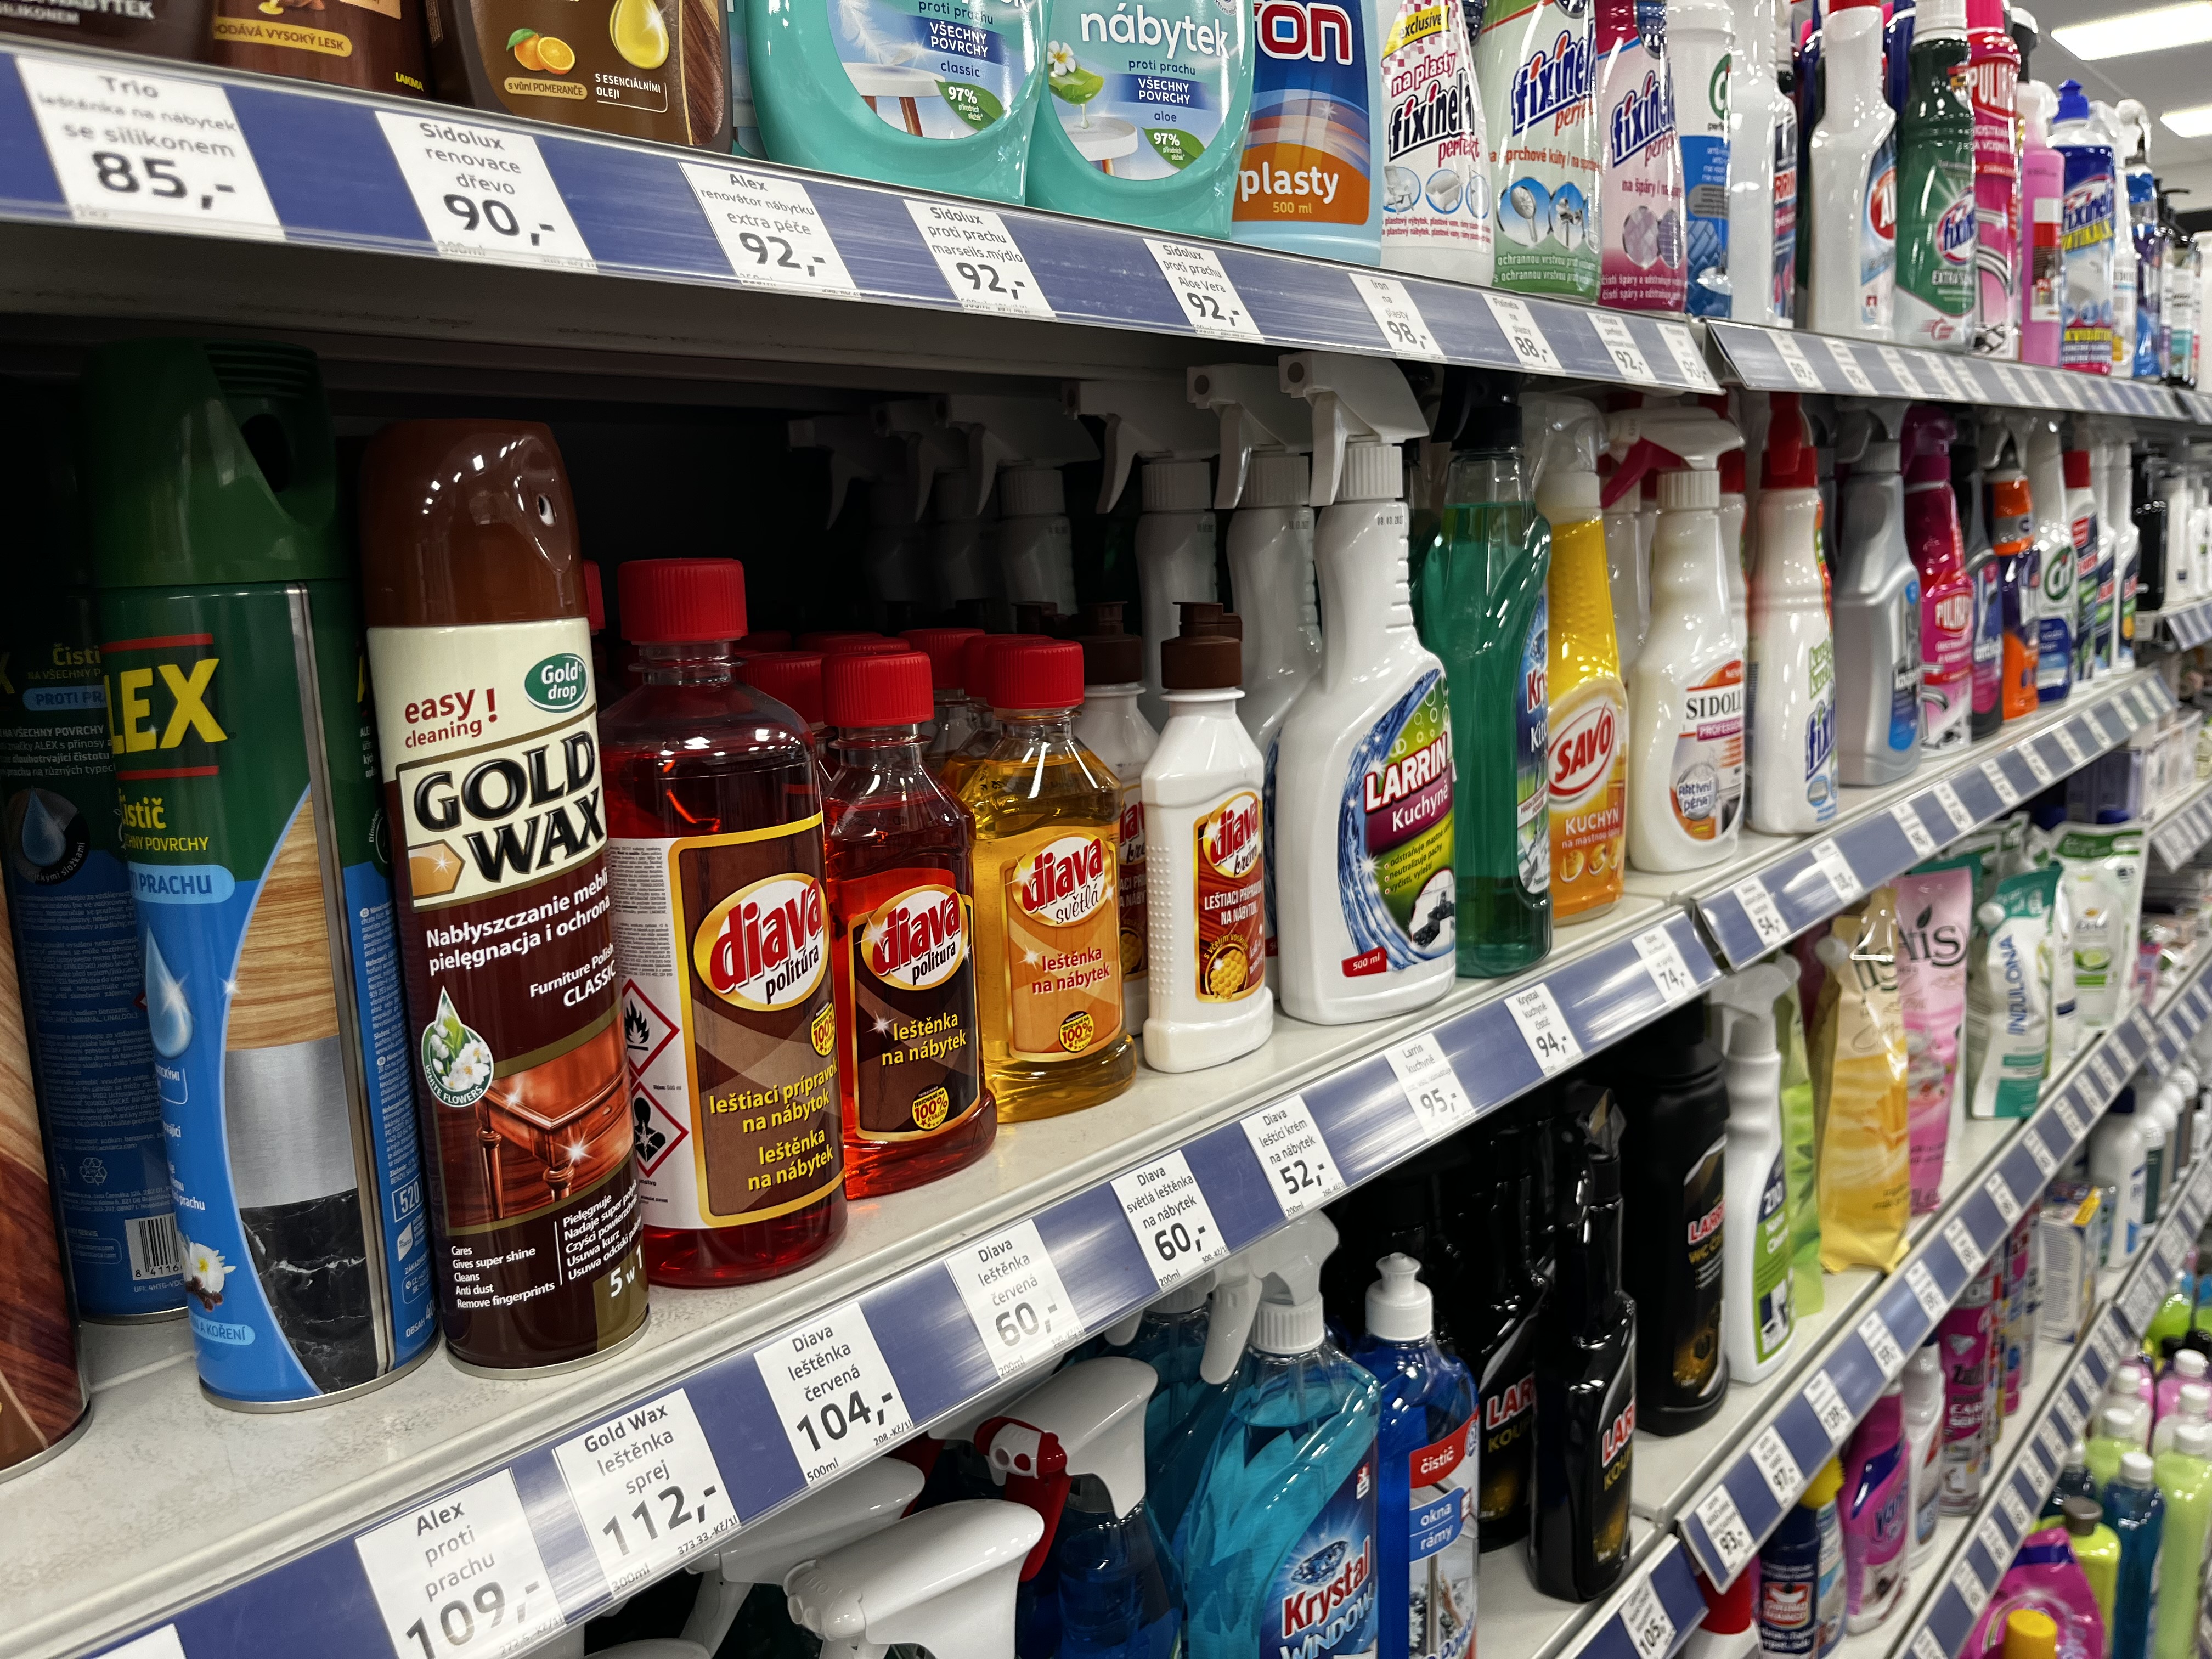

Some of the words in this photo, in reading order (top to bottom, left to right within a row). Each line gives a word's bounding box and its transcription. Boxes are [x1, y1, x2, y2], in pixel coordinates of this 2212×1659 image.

[918, 0, 950, 15] proti
[954, 4, 994, 25] prachu
[266, 26, 315, 45] VYSOKÝ
[318, 34, 344, 51] LESK
[929, 20, 986, 44] VŠECHNY
[1081, 7, 1229, 59] nábytek
[1398, 13, 1442, 41] exclusive
[930, 36, 988, 57] POVRCHY
[940, 60, 980, 78] classic
[1128, 59, 1156, 72] proti
[1160, 62, 1196, 76] prachu
[98, 75, 159, 98] Trio
[395, 72, 424, 92] LAKMA
[514, 80, 532, 92] vůní
[533, 81, 584, 97] POMERANČE
[596, 86, 620, 100] OLEJI
[603, 74, 661, 94] ESENCIÁLNÍMI
[947, 86, 977, 104] 97%
[1138, 76, 1189, 93] VŠECHNY
[1138, 89, 1190, 105] POVRCHY
[161, 109, 237, 132] nábytek
[1154, 110, 1177, 122] aloe
[63, 122, 94, 139] se
[105, 126, 235, 158] silikonem
[419, 121, 505, 151] Sidolux
[1153, 132, 1180, 146] 97%
[425, 146, 521, 174] renovace
[91, 151, 235, 210] 85,-
[456, 172, 516, 195] dřevo
[729, 173, 768, 191] Alex
[1238, 162, 1338, 204] plasty
[699, 187, 763, 208] renovátor
[766, 200, 815, 216] nábytku
[1273, 201, 1295, 213] 500
[1298, 203, 1312, 213] ml
[443, 194, 555, 246] 90,-
[727, 211, 771, 229] extra
[775, 217, 811, 235] péče
[930, 207, 984, 225] Sidolux
[927, 223, 960, 240] proti
[962, 227, 1007, 244] prachu
[738, 232, 826, 277] 92,-
[1163, 244, 1204, 261] Sidolux
[956, 262, 1025, 300] 92,-
[1164, 259, 1187, 273] proti
[1188, 263, 1222, 279] prachu
[1178, 276, 1202, 290] Aloe
[1202, 281, 1226, 294] Vera
[1187, 293, 1240, 326] 92,-
[1386, 321, 1426, 349] 98,-
[1514, 336, 1547, 363] 88,-
[1615, 350, 1645, 374] 92,-
[540, 665, 579, 686] Gold
[35, 692, 79, 707] PROTI
[104, 658, 229, 754] LEX
[404, 688, 476, 724] easy
[548, 684, 577, 701] drop
[405, 719, 483, 749] cleaning
[1554, 701, 1612, 783] SAVO
[413, 730, 596, 832] GOLD
[1364, 732, 1447, 813] LARRIN
[1392, 780, 1448, 832] Kuchyně
[1565, 803, 1619, 836] KUCHYŇ
[145, 836, 209, 852] POVRCHY
[463, 786, 607, 884] WAX
[1390, 842, 1424, 866] odstraňuje
[1390, 854, 1426, 878] neutralizuje
[1427, 842, 1443, 859] pachy
[140, 873, 213, 895] PRACHU
[1022, 838, 1103, 912] diava
[1204, 889, 1238, 910] LEŠTIACI
[425, 895, 571, 948] Nabłyszczanie
[1221, 911, 1232, 925] NA
[709, 877, 823, 995] diava
[872, 891, 961, 975] diava
[429, 925, 541, 976] pielęgnacja
[911, 940, 956, 985] politura
[1041, 946, 1102, 973] leštěnka
[1352, 958, 1368, 971] 500
[1370, 952, 1380, 964] ml
[1032, 978, 1053, 994] na
[1056, 963, 1110, 990] nábytek
[1659, 968, 1686, 991] 74,-
[2005, 933, 2027, 1035] INDULONA
[1516, 990, 1539, 1006] Krystal
[894, 1011, 958, 1041] leštěnka
[881, 1046, 906, 1066] na
[908, 1029, 967, 1060] nábytek
[1536, 1033, 1567, 1058] 94,-
[443, 1085, 484, 1104] FLOWERS
[709, 1084, 779, 1114] leštiaci
[1420, 1088, 1457, 1118] 95,-
[742, 1114, 767, 1134] na
[770, 1091, 830, 1127] nábytok
[1262, 1108, 1288, 1126] Diava
[1286, 1117, 1307, 1138] krém
[758, 1129, 825, 1165] leštěnka
[1269, 1152, 1282, 1165] na
[1283, 1135, 1316, 1161] nábytek
[747, 1170, 773, 1192] na
[775, 1148, 833, 1186] nábytek
[1136, 1165, 1166, 1187] Diava
[1279, 1159, 1325, 1195] 52,-
[400, 1181, 420, 1212] 520
[1126, 1192, 1155, 1215] světlá
[1154, 1173, 1194, 1203] leštěnka
[1142, 1213, 1161, 1229] na
[1162, 1194, 1197, 1221] nábytek
[564, 1218, 598, 1240] Nadaje
[1153, 1222, 1206, 1261] 60,-
[451, 1245, 472, 1256] Cares
[453, 1258, 474, 1269] Gives
[476, 1254, 504, 1269] super
[506, 1245, 536, 1261] shine
[567, 1244, 600, 1267] Usuwa
[603, 1229, 620, 1249] kurz
[977, 1238, 1013, 1262] Diava
[454, 1272, 479, 1283] Cleans
[568, 1257, 602, 1280] Usuwa
[978, 1254, 1031, 1287] leštěnka
[1159, 1268, 1181, 1288] 200ml
[455, 1285, 471, 1295] Anti
[473, 1283, 494, 1295] dust
[456, 1297, 490, 1308] Remove
[492, 1280, 555, 1306] fingerprints
[990, 1272, 1038, 1307] červená
[405, 1318, 425, 1338] OBSAH
[995, 1302, 1058, 1347] 60,-
[791, 1325, 833, 1353] Diava
[787, 1342, 851, 1381] leštěnka
[804, 1362, 861, 1402] červená
[584, 1422, 626, 1453] Gold
[627, 1404, 668, 1431] Wax
[796, 1390, 893, 1451] 104,-
[597, 1429, 674, 1476] leštěnka
[1420, 1444, 1455, 1475] čistič
[625, 1459, 671, 1495] sprej
[806, 1457, 839, 1482] 500ml
[416, 1500, 465, 1536] Alex
[602, 1485, 716, 1557] 112,-
[1420, 1501, 1452, 1527] okna
[425, 1525, 476, 1568] proti
[424, 1551, 495, 1601] prachu
[1282, 1539, 1370, 1639] Krystal
[405, 1580, 539, 1658] 109,-
